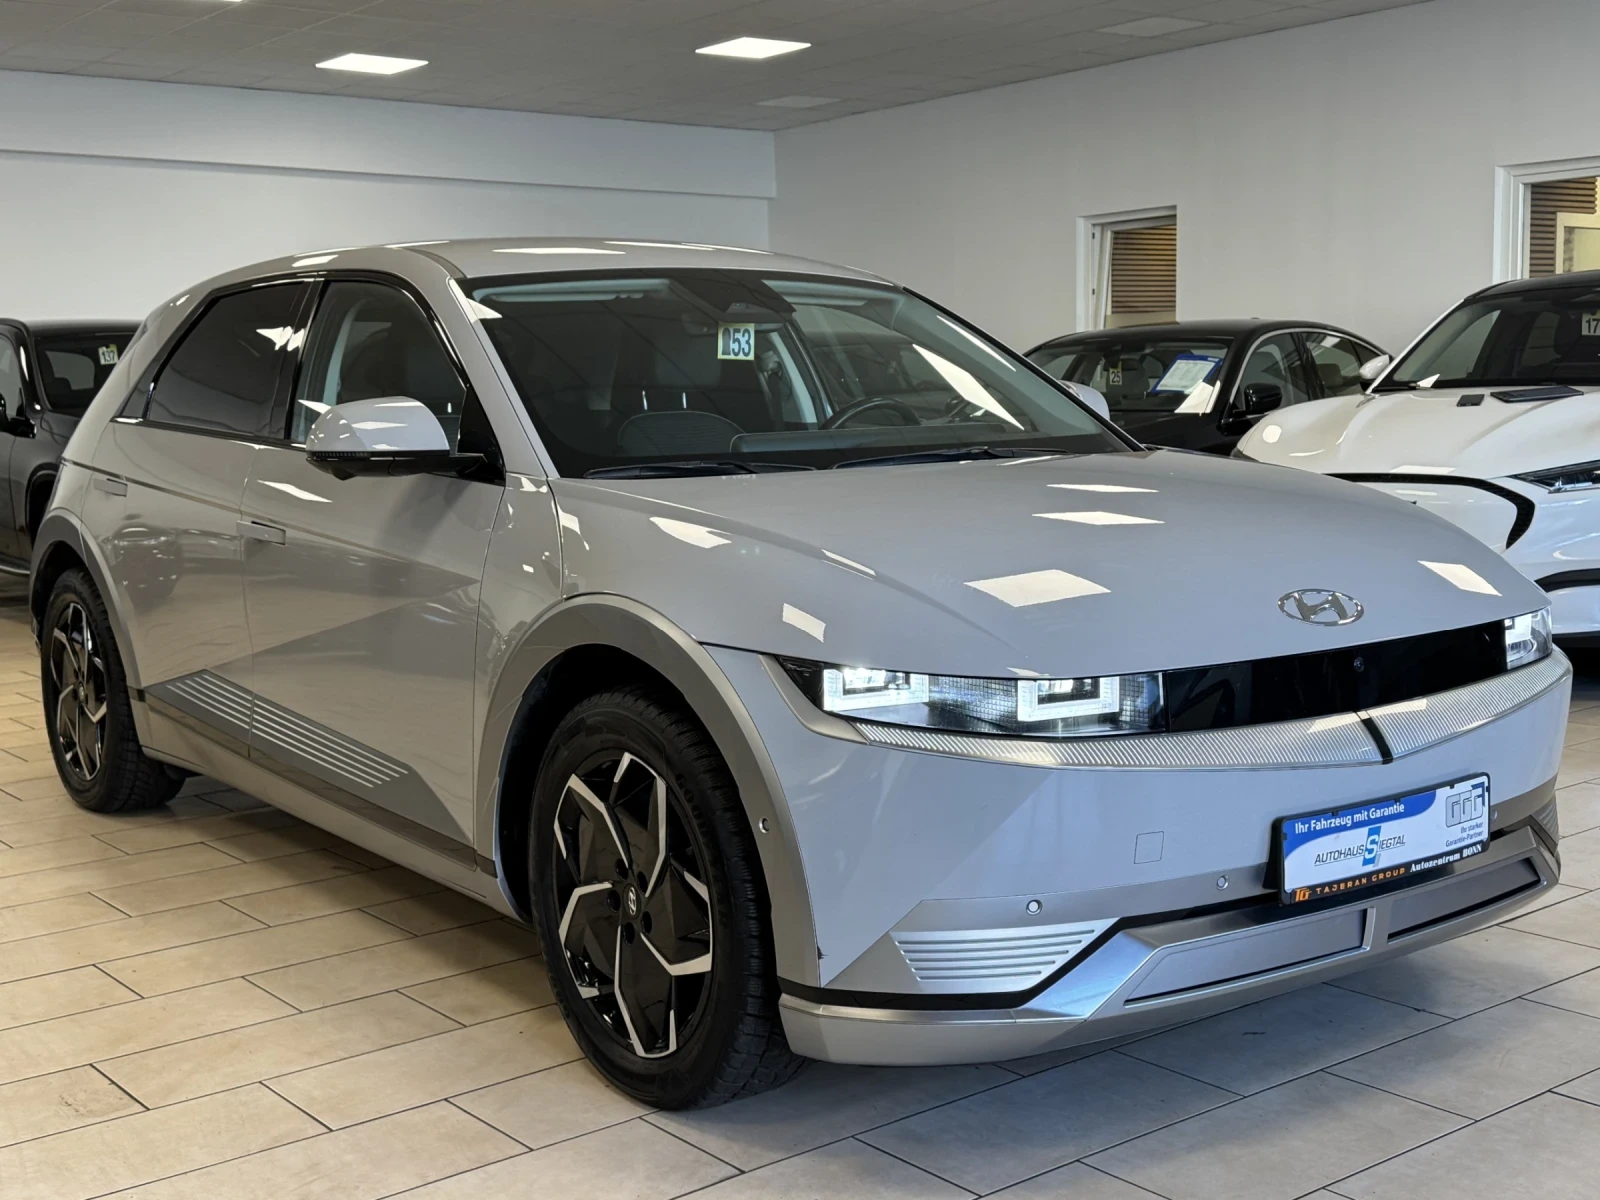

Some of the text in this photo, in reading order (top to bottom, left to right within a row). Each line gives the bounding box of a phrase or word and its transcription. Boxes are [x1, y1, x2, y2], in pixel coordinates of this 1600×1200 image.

[1111, 370, 1121, 384] 25
[1295, 803, 1405, 834] Ihr Fahrzeug mit Garantie
[1314, 843, 1364, 864] AUTOHAUS
[1316, 877, 1367, 894] TAJERAN
[1372, 867, 1406, 882] GROUP
[1410, 852, 1460, 873] Autozentrum
[1462, 843, 1482, 858] BONN
